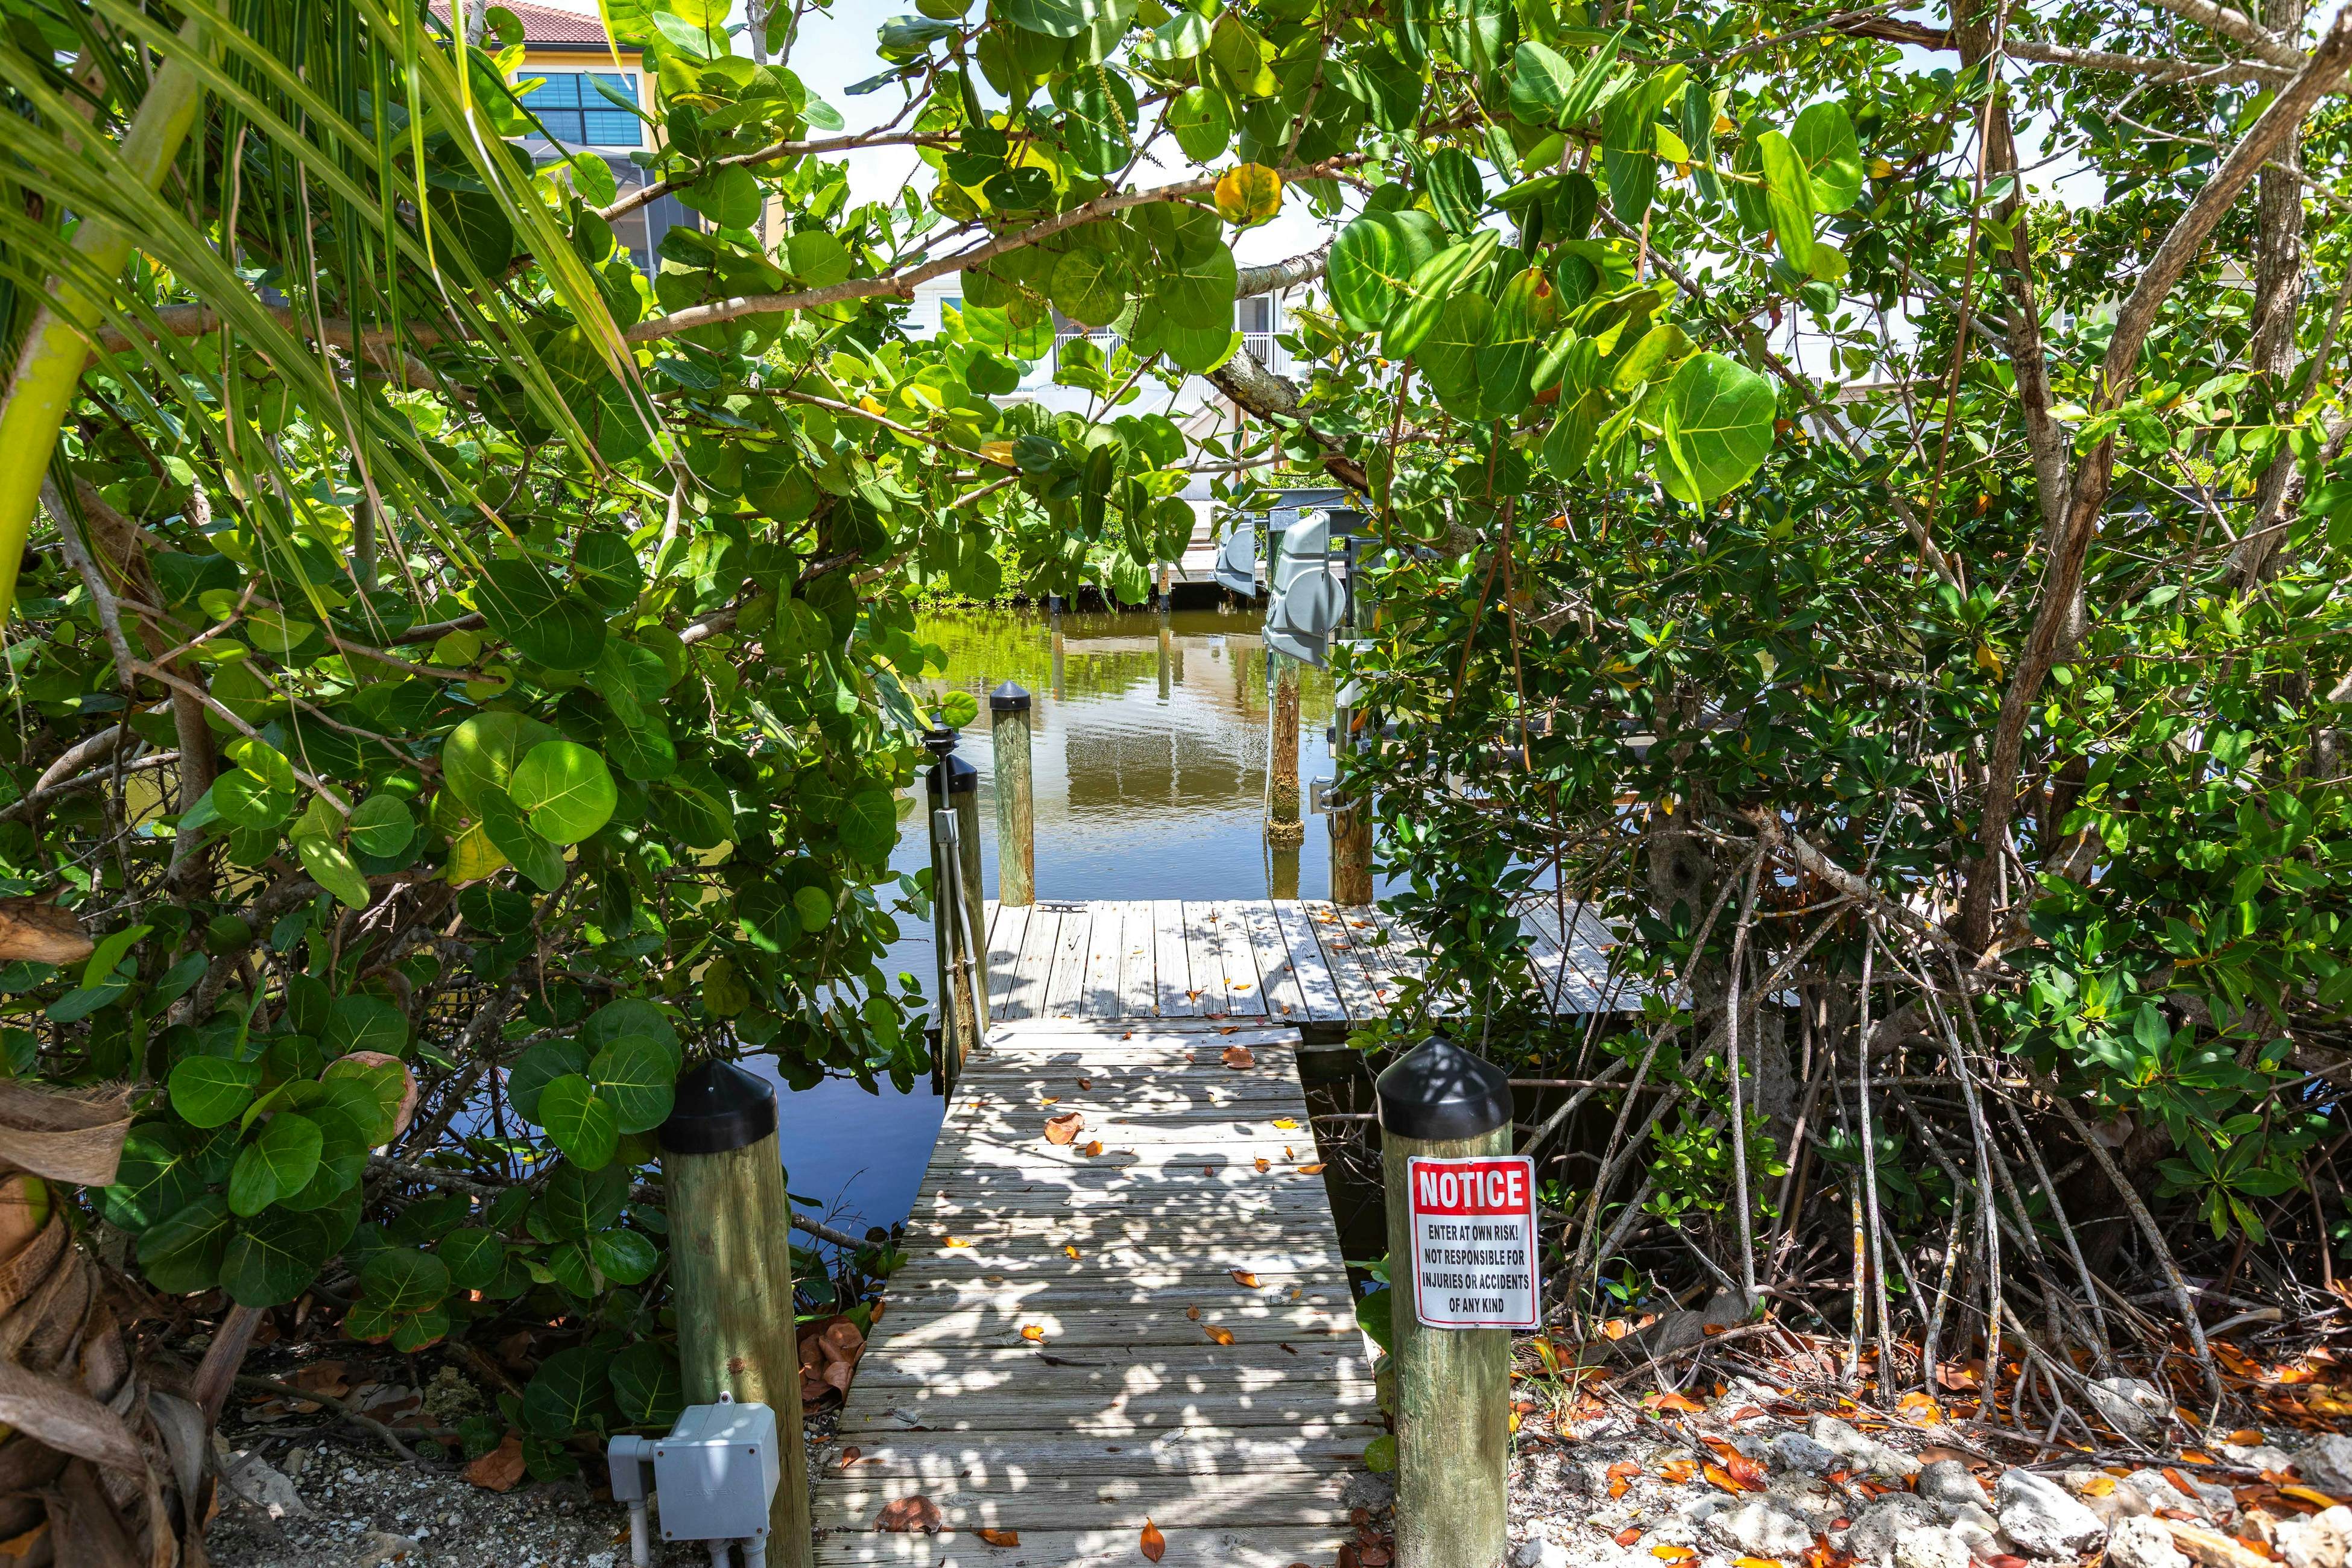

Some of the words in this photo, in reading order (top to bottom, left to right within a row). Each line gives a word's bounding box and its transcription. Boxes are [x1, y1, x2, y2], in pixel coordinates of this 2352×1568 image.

[1420, 1170, 1523, 1208] NOTICE
[1428, 1224, 1457, 1241] ENTER
[1459, 1225, 1470, 1241] AT
[1472, 1225, 1492, 1241] OWN
[1494, 1225, 1519, 1241] RISK!
[1424, 1248, 1443, 1264] NOT
[1444, 1250, 1505, 1265] RESPONSIBLE
[1507, 1250, 1525, 1265] FOR
[1423, 1272, 1462, 1289] INJURIES
[1465, 1274, 1477, 1289] OR
[1479, 1274, 1529, 1289] ACCIDENTS
[1449, 1298, 1460, 1312] OF
[1462, 1298, 1479, 1313] ANY
[1482, 1298, 1504, 1313] KIND
